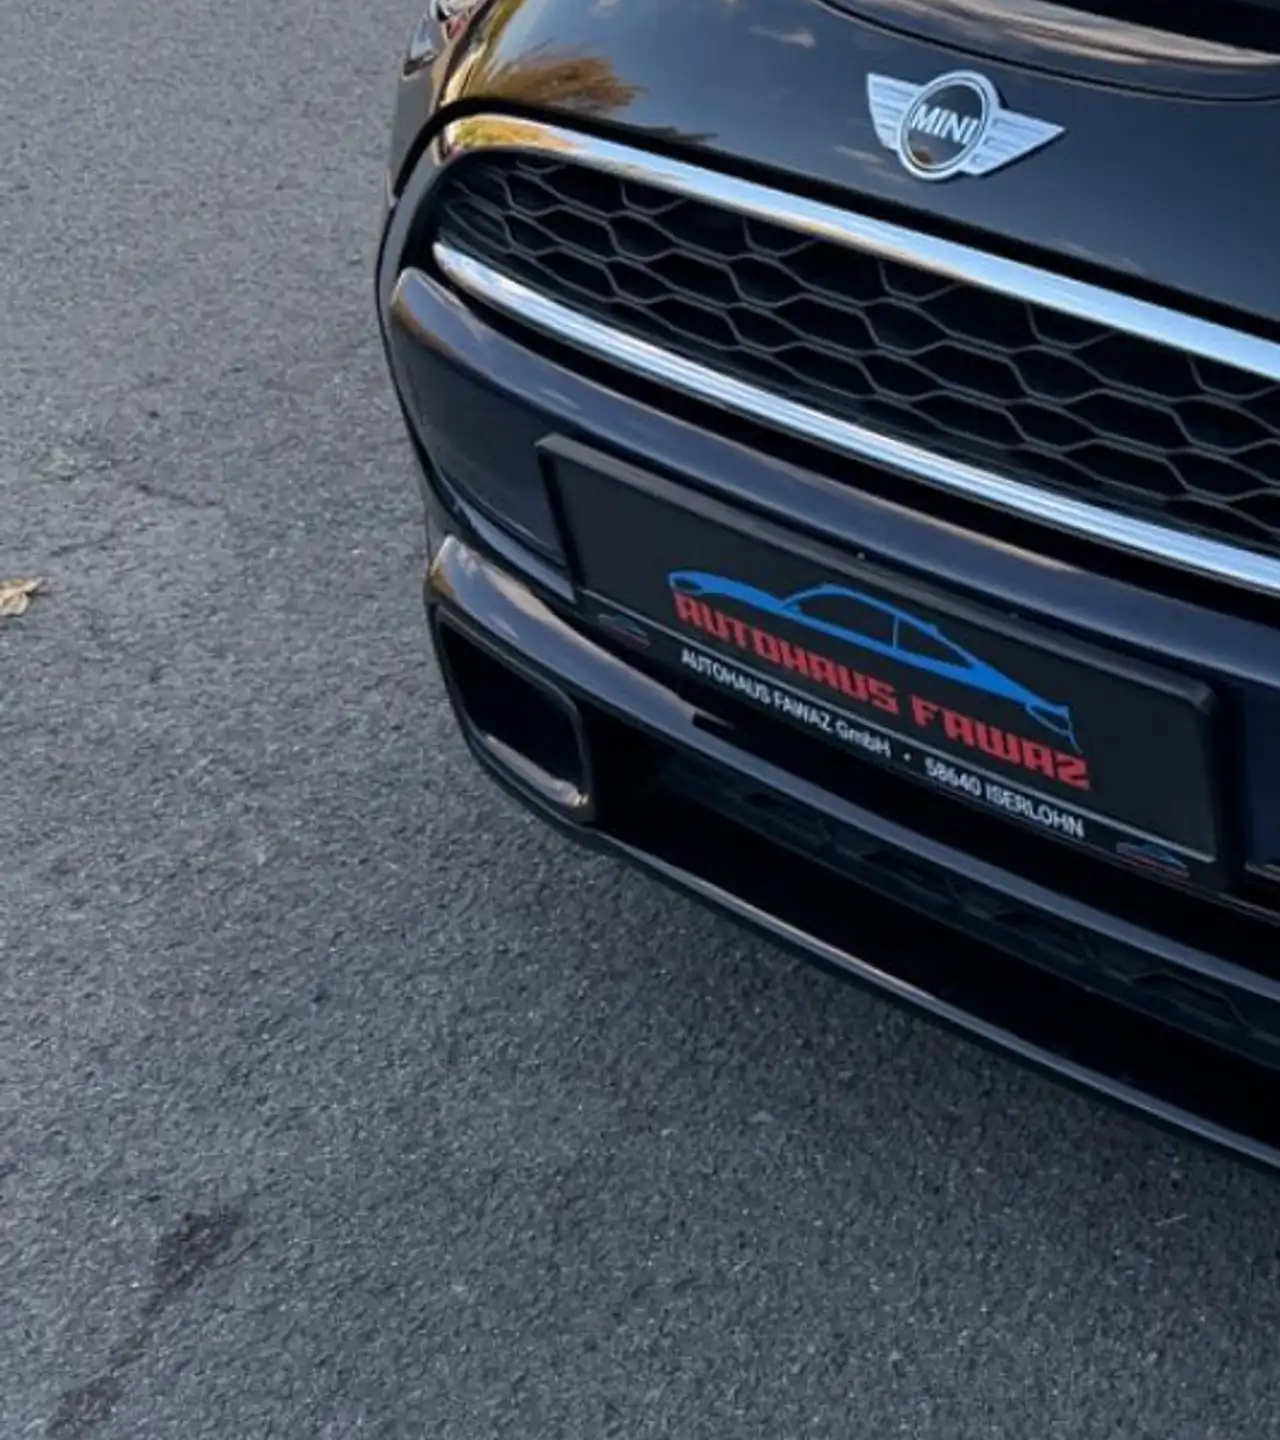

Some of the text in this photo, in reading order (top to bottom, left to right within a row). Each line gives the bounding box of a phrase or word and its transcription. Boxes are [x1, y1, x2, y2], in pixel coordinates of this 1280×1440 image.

[911, 103, 981, 146] MINI
[673, 592, 1092, 791] AUTOHAUS FAWAZ
[680, 647, 1086, 839] AUTOHAUS FAWAZ GmbH 58640 ISERLOHN
